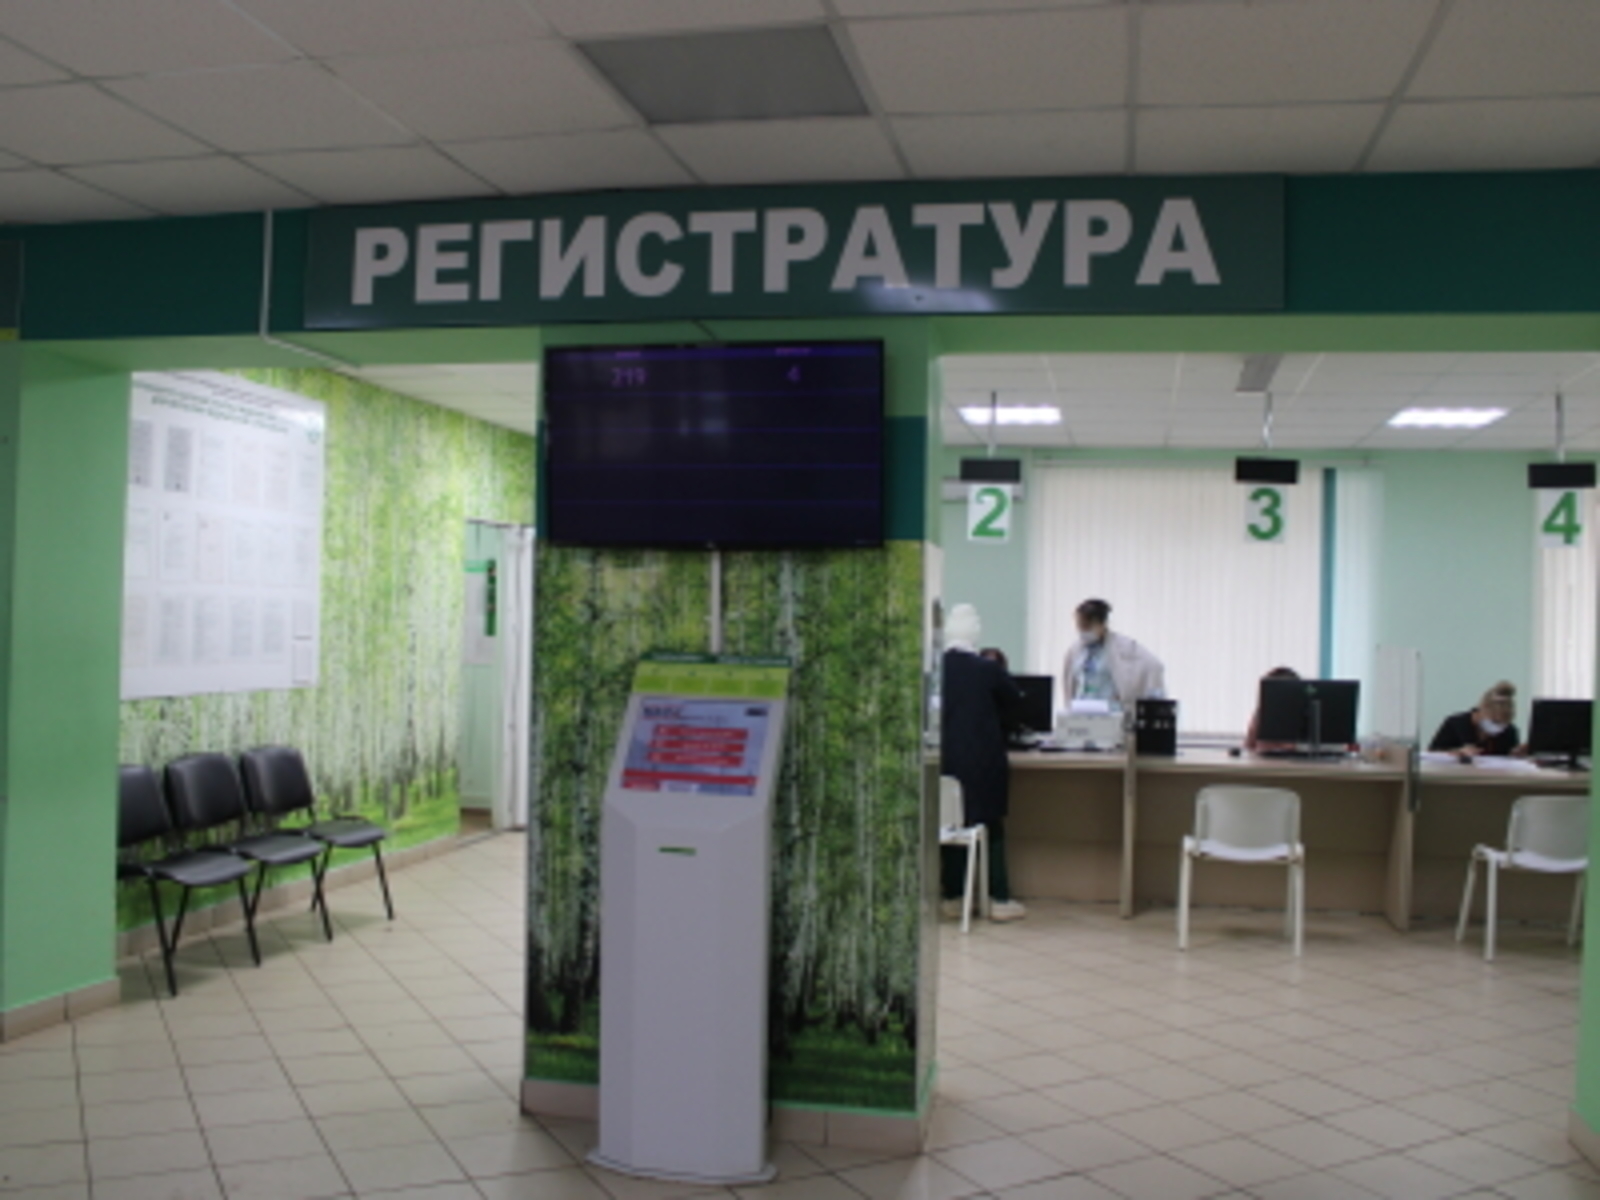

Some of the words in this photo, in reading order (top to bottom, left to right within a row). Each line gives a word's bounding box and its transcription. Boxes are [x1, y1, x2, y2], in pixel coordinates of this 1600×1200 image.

[350, 197, 1221, 305] РЕГИСТРАТУРА
[970, 487, 1010, 539] 2
[1246, 487, 1285, 542] 3
[1541, 491, 1583, 546] 4
